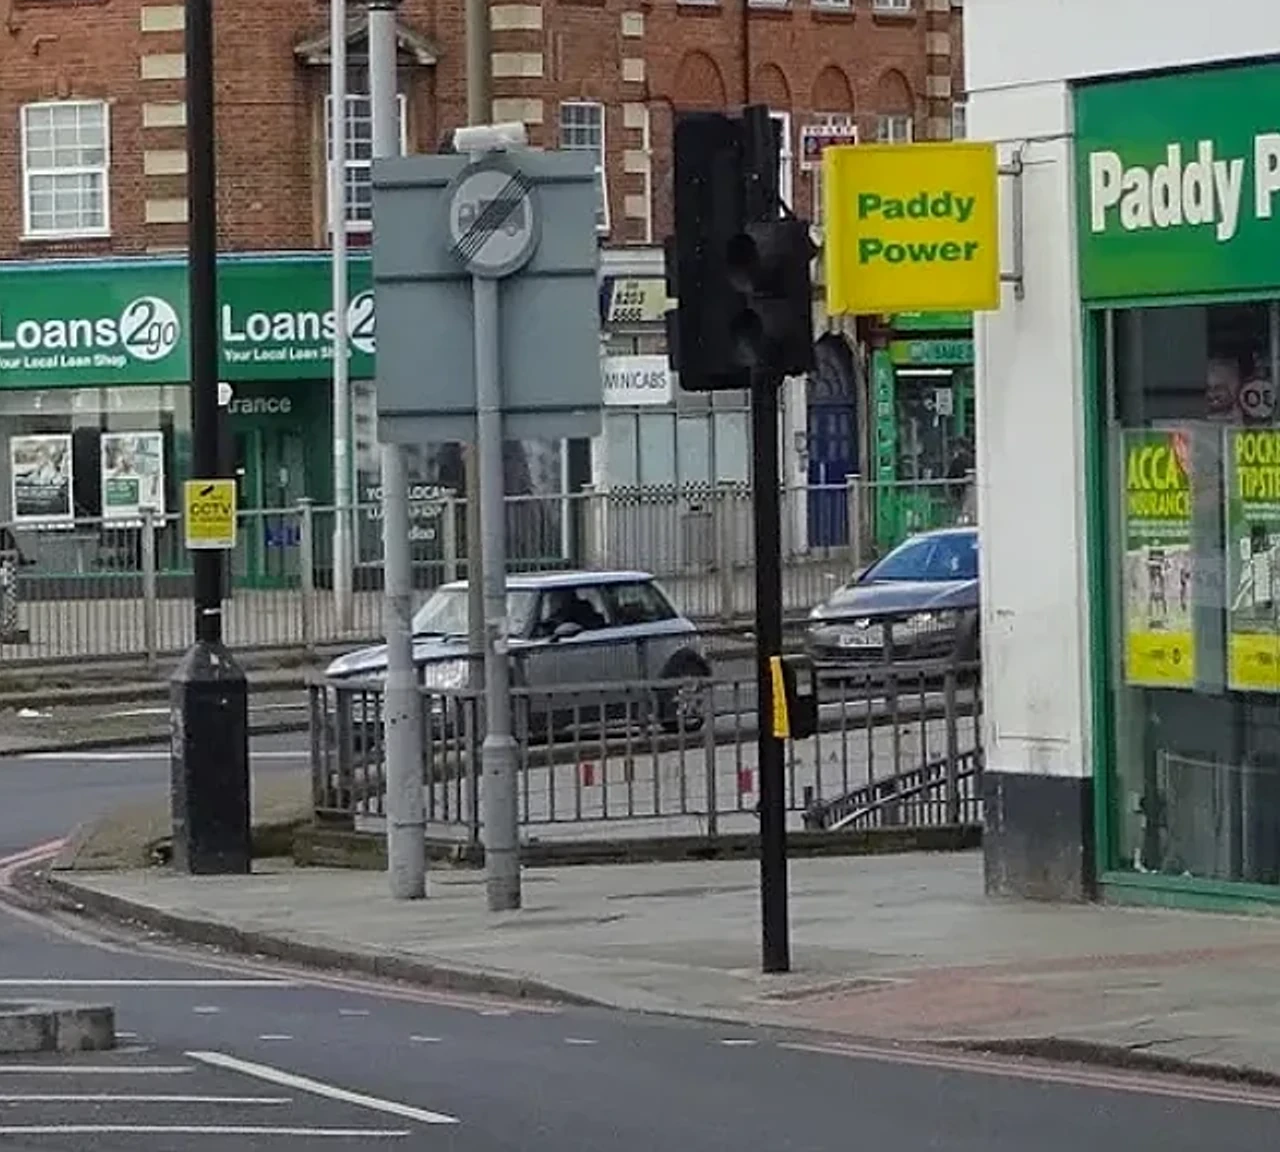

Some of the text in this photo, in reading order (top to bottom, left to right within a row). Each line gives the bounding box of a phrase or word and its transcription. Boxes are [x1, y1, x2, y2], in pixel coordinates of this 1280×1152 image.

[1090, 139, 1245, 242] Paddy
[857, 191, 976, 224] Paddy
[858, 237, 979, 265] Power
[23, 354, 58, 368] Local
[60, 354, 91, 367] Loan
[93, 354, 128, 369] Shop
[223, 345, 353, 362] Your Local Loan Shp
[604, 370, 668, 390] MINICABS
[227, 396, 292, 414] rance
[1128, 447, 1180, 490] ACCA
[190, 501, 232, 516] CCTV
